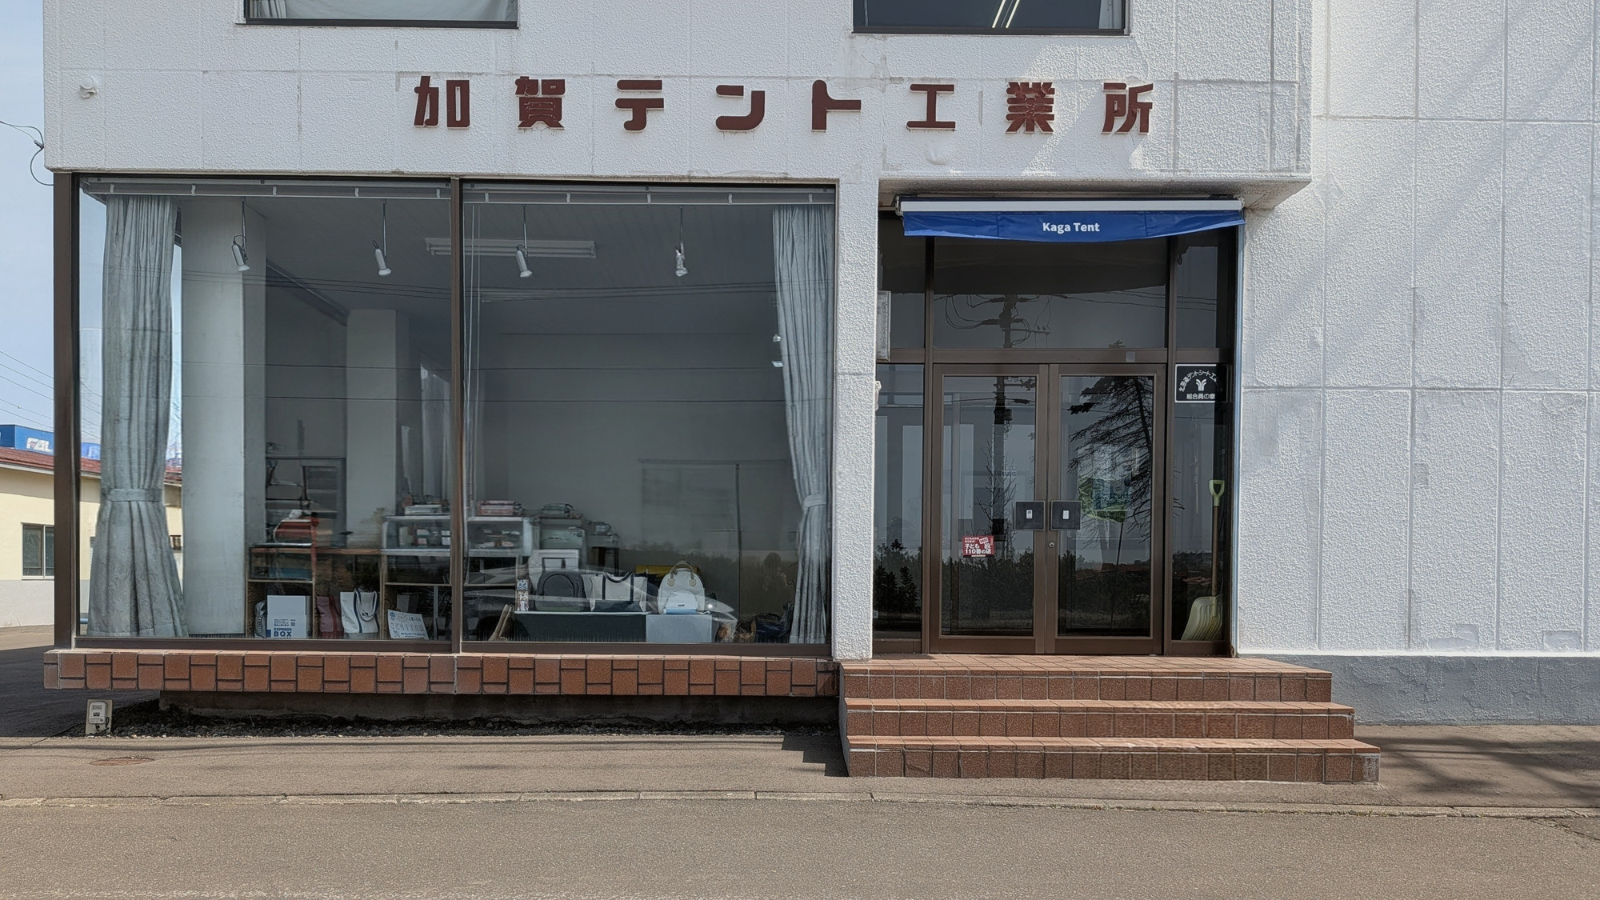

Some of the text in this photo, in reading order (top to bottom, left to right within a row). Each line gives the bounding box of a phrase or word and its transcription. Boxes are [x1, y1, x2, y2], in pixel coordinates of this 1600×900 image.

[413, 75, 1154, 134] 加賀テント工業所
[1042, 222, 1100, 235] Kaga Tent
